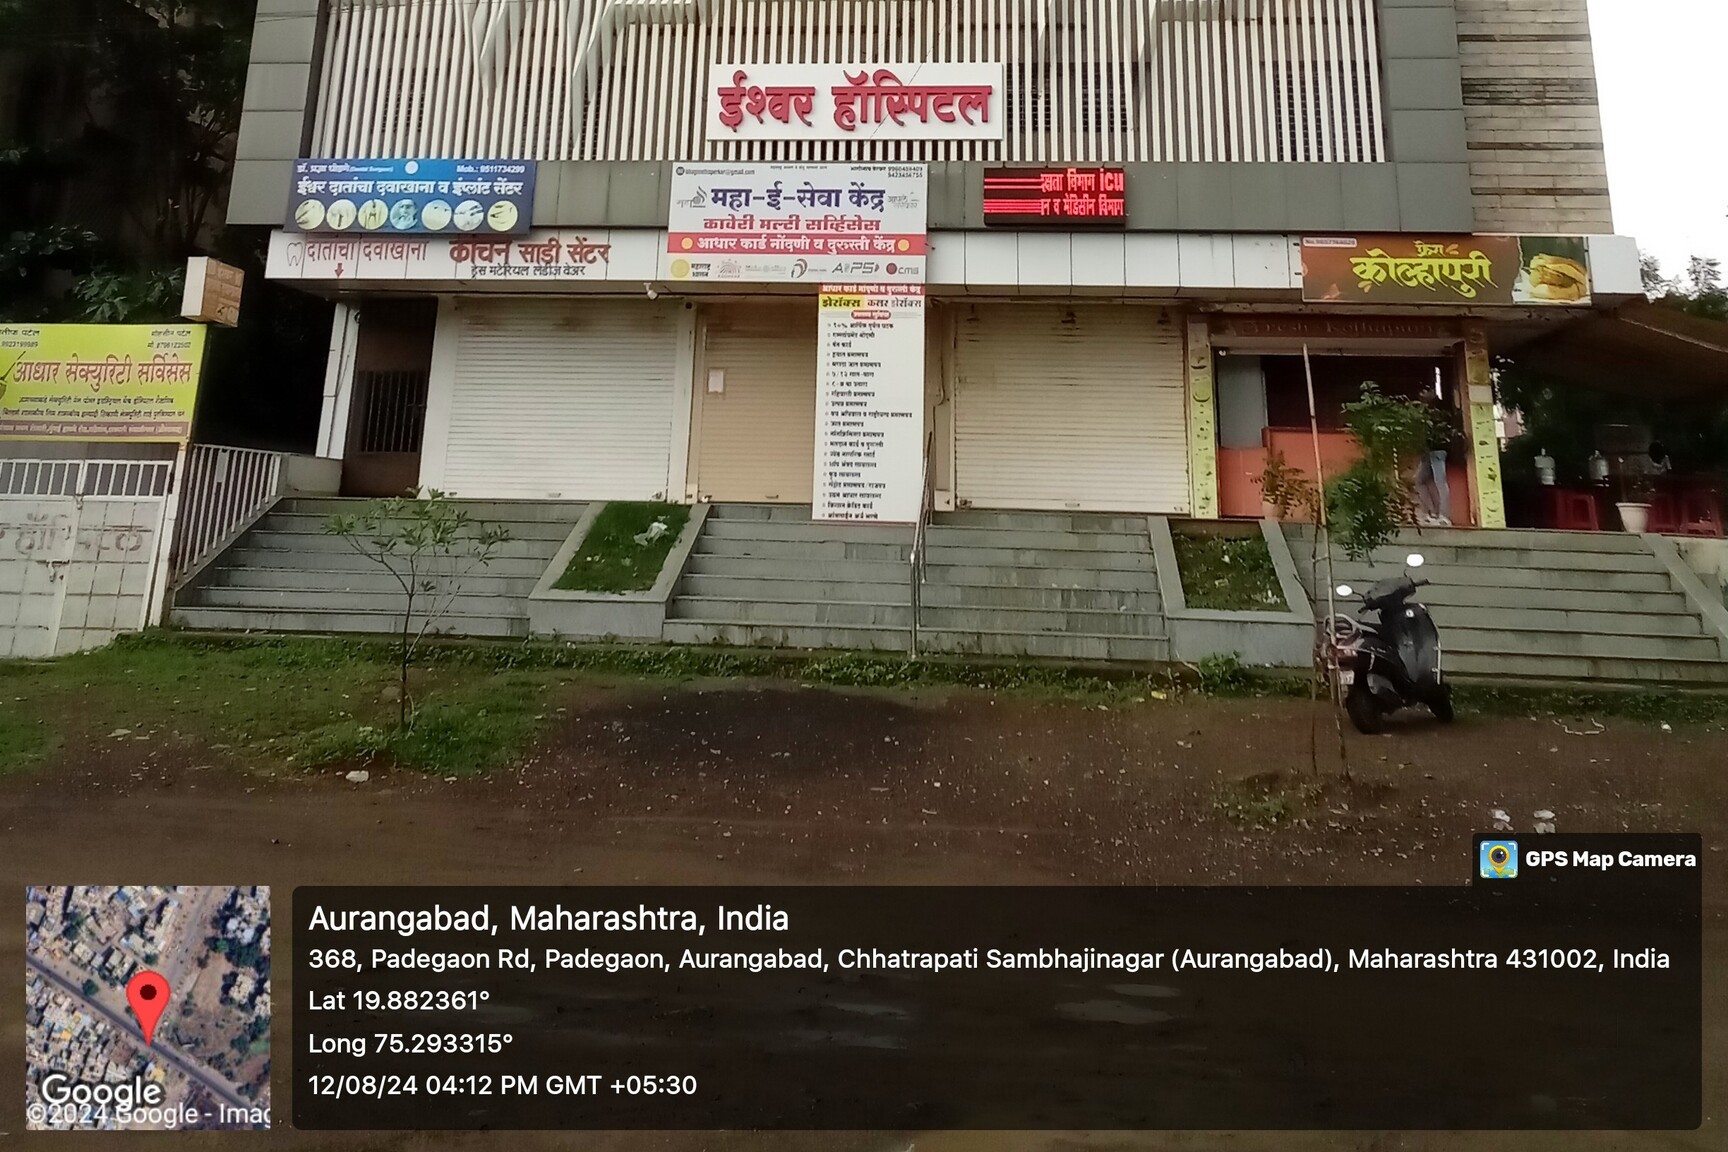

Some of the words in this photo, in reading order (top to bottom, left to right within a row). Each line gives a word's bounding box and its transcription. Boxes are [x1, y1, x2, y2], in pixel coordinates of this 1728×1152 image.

[717, 69, 816, 132] ईश्वर
[831, 68, 993, 132] हॉस्पिटल
[297, 176, 327, 195] ईश्वर
[376, 179, 436, 196] दवाखाना
[438, 181, 450, 194] व
[493, 176, 524, 195] सेंटर
[848, 181, 886, 213] केंद्र
[703, 214, 754, 231] कावेरी
[760, 214, 800, 231] मल्टी
[360, 239, 430, 261] दवाखाना
[567, 236, 612, 264] सेंटर
[697, 236, 737, 250] आधार
[740, 234, 767, 250] कार्ड
[769, 234, 811, 252] नोंदणी
[813, 238, 825, 250] व
[13, 361, 61, 384] आधार
[66, 352, 132, 393] सेक्युरिटी
[138, 352, 193, 385] सर्विसेस
